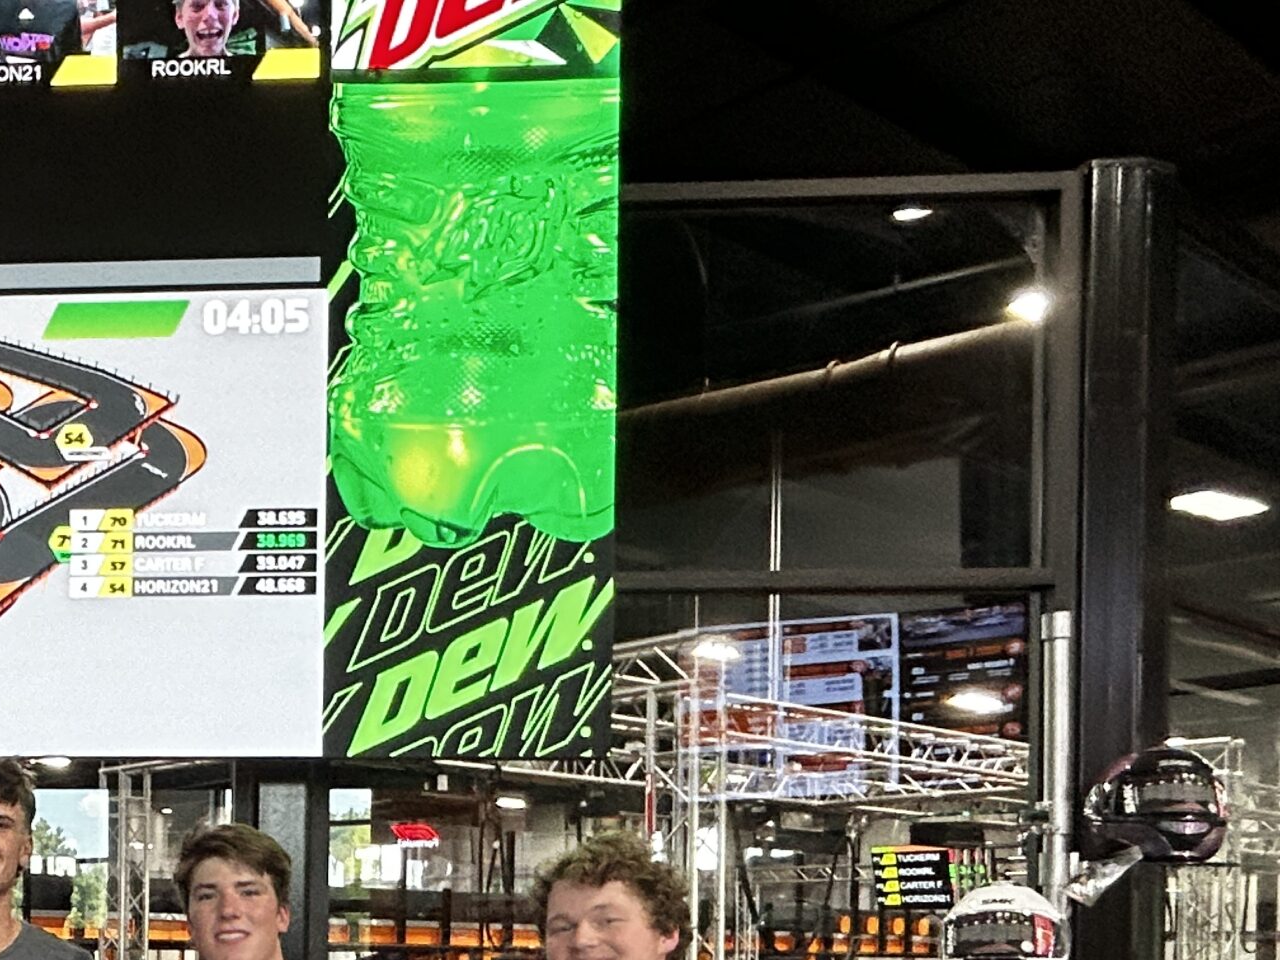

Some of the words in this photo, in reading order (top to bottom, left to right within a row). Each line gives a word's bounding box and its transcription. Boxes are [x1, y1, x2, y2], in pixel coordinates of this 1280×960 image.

[151, 58, 231, 78] ROOKRL
[203, 298, 309, 336] 04:05
[64, 432, 85, 445] 54
[109, 516, 127, 527] 70
[110, 539, 125, 549] 71
[134, 535, 197, 549] ROOKRL
[110, 561, 126, 571] 57
[109, 583, 125, 593] 54
[134, 579, 219, 594] HORIZON21
